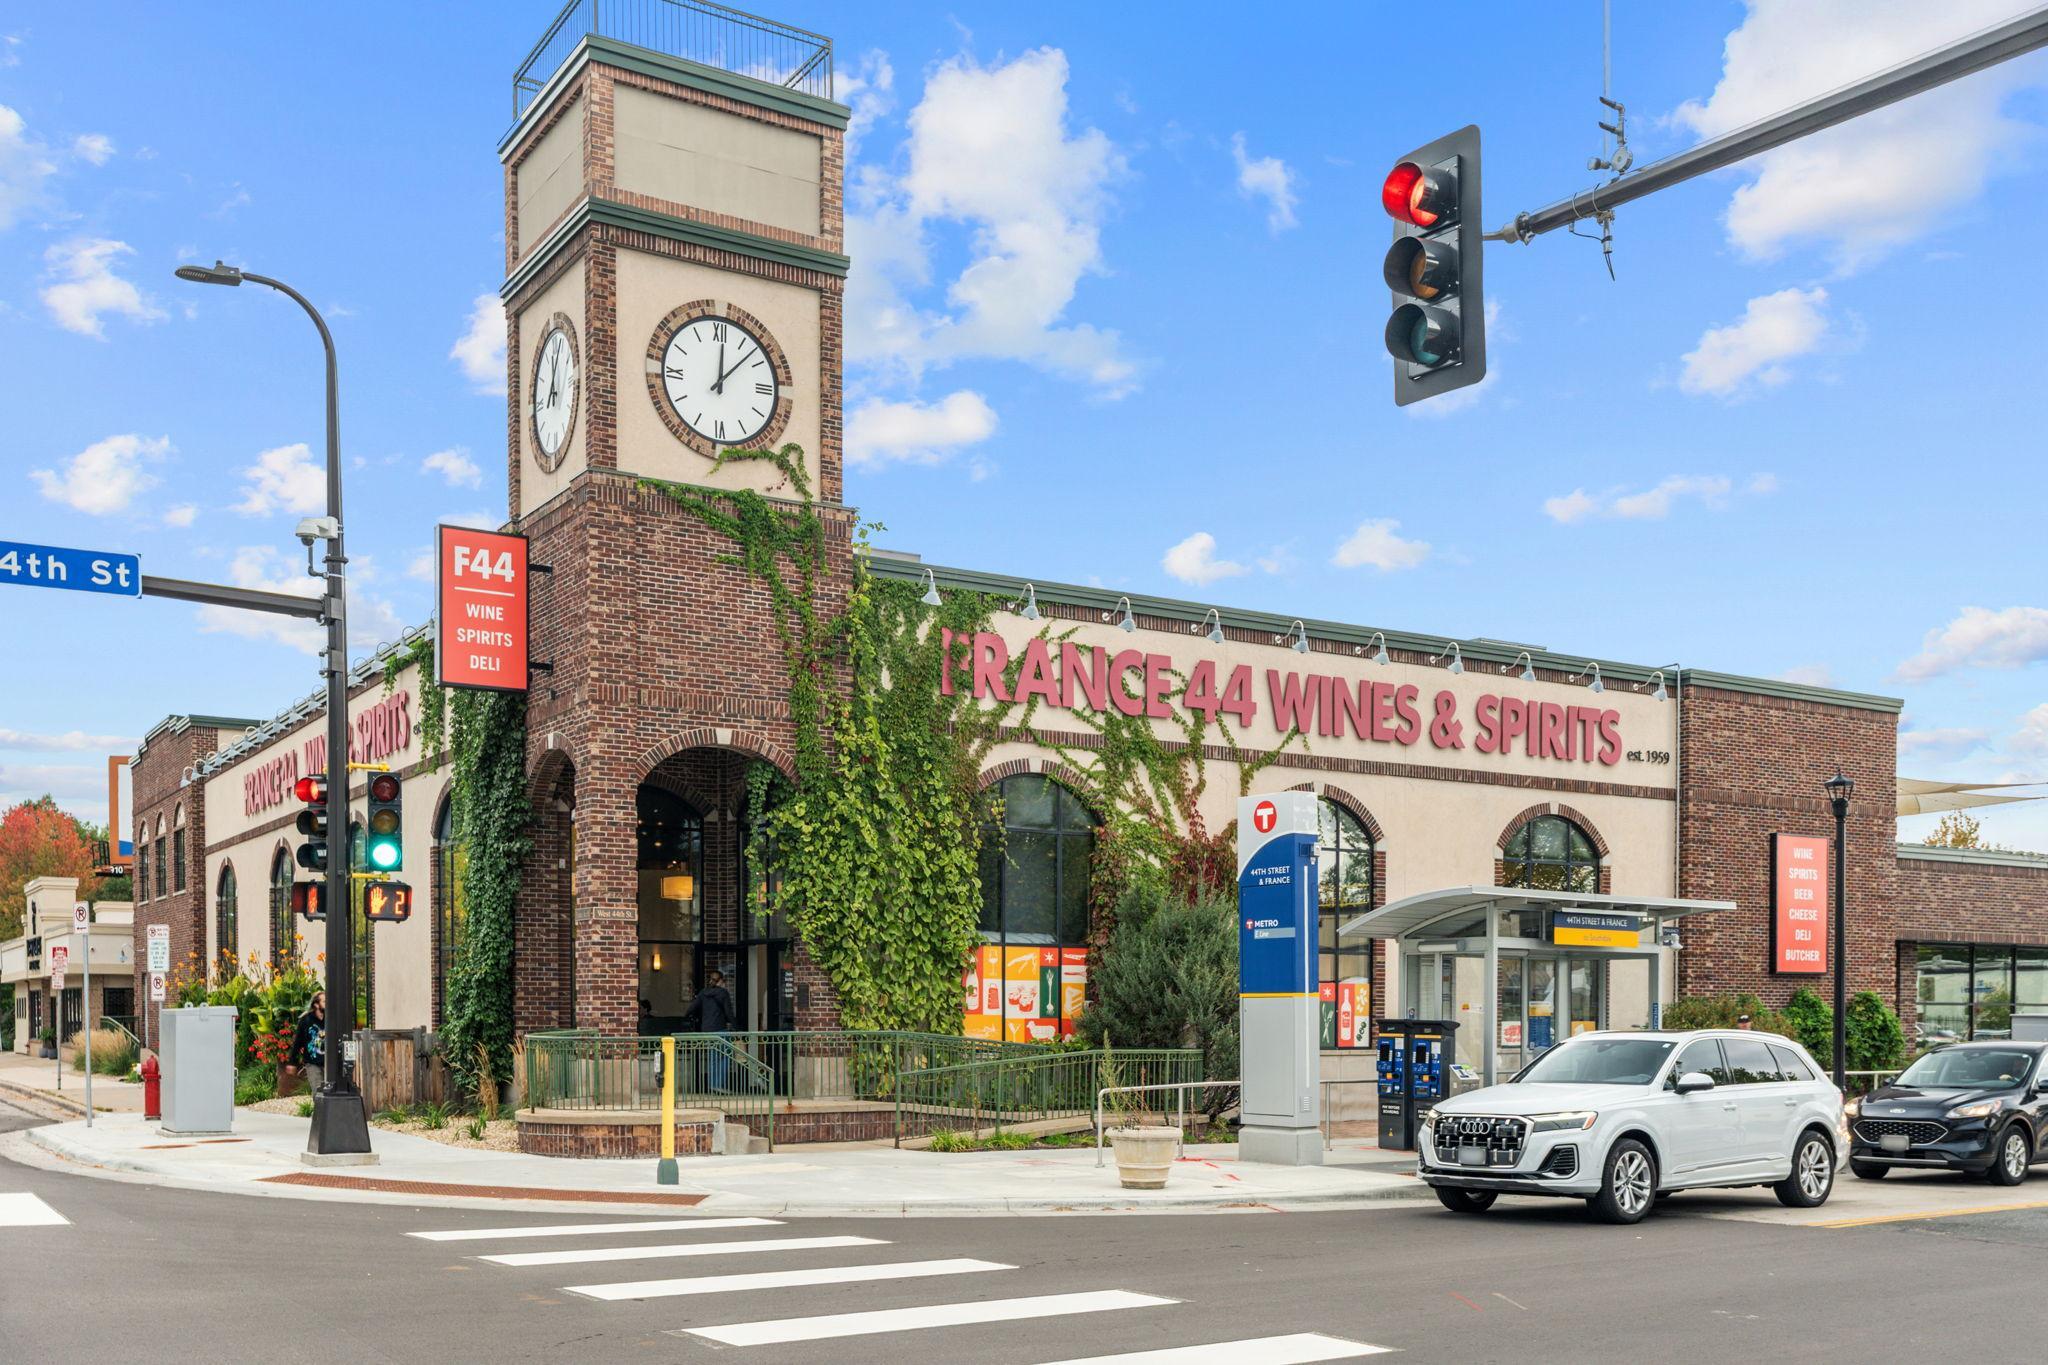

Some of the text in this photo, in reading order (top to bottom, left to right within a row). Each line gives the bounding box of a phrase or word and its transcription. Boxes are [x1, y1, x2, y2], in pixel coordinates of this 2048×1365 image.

[713, 322, 727, 343] XII
[454, 545, 515, 583] F44
[91, 559, 130, 588] St
[466, 603, 504, 621] WINE
[457, 627, 513, 647] SPIRITS
[469, 655, 500, 671] DELI
[941, 627, 1622, 766] FRANCE 44 WINES & SPIRITS
[355, 689, 410, 764] SPIRITS
[1626, 750, 1670, 765] est. 1959
[1257, 808, 1273, 829] T
[1793, 847, 1813, 859] WINE
[1251, 865, 1290, 876] 44TH STREET
[1789, 867, 1818, 880] SPIRITS
[1265, 876, 1291, 885] FRANCE
[1794, 888, 1814, 900] BEER
[394, 891, 406, 915] 2
[1566, 916, 1628, 927] 44TH STREET & FRANCE
[1789, 908, 1818, 920] CHEESE
[1254, 919, 1279, 928] METRO
[1795, 929, 1812, 940] DELI
[1785, 949, 1820, 961] BUTCHER
